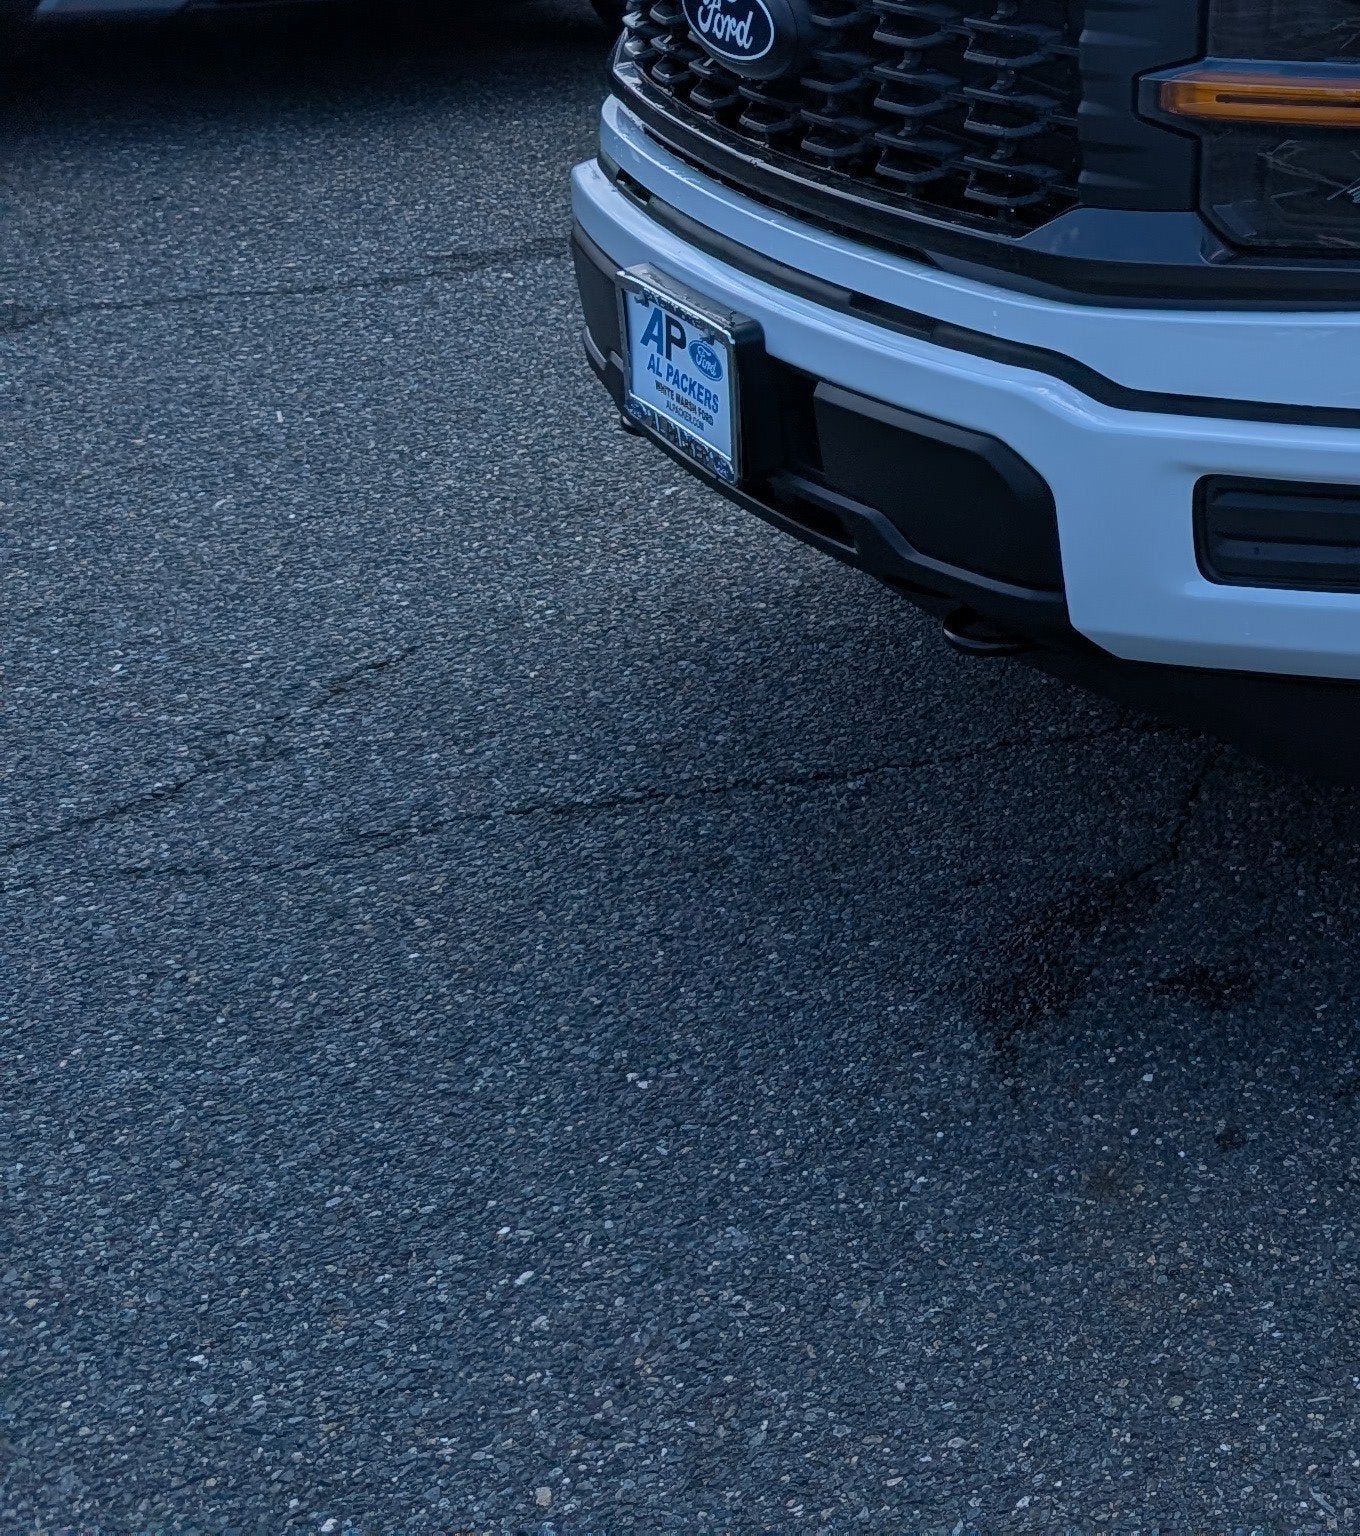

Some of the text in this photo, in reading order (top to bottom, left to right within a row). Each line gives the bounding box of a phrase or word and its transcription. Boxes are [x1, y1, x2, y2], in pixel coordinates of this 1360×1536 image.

[640, 307, 687, 362] AP
[695, 346, 717, 377] Ford
[647, 354, 663, 378] AL
[665, 364, 719, 414] PACKERS
[655, 379, 675, 401] WHITE
